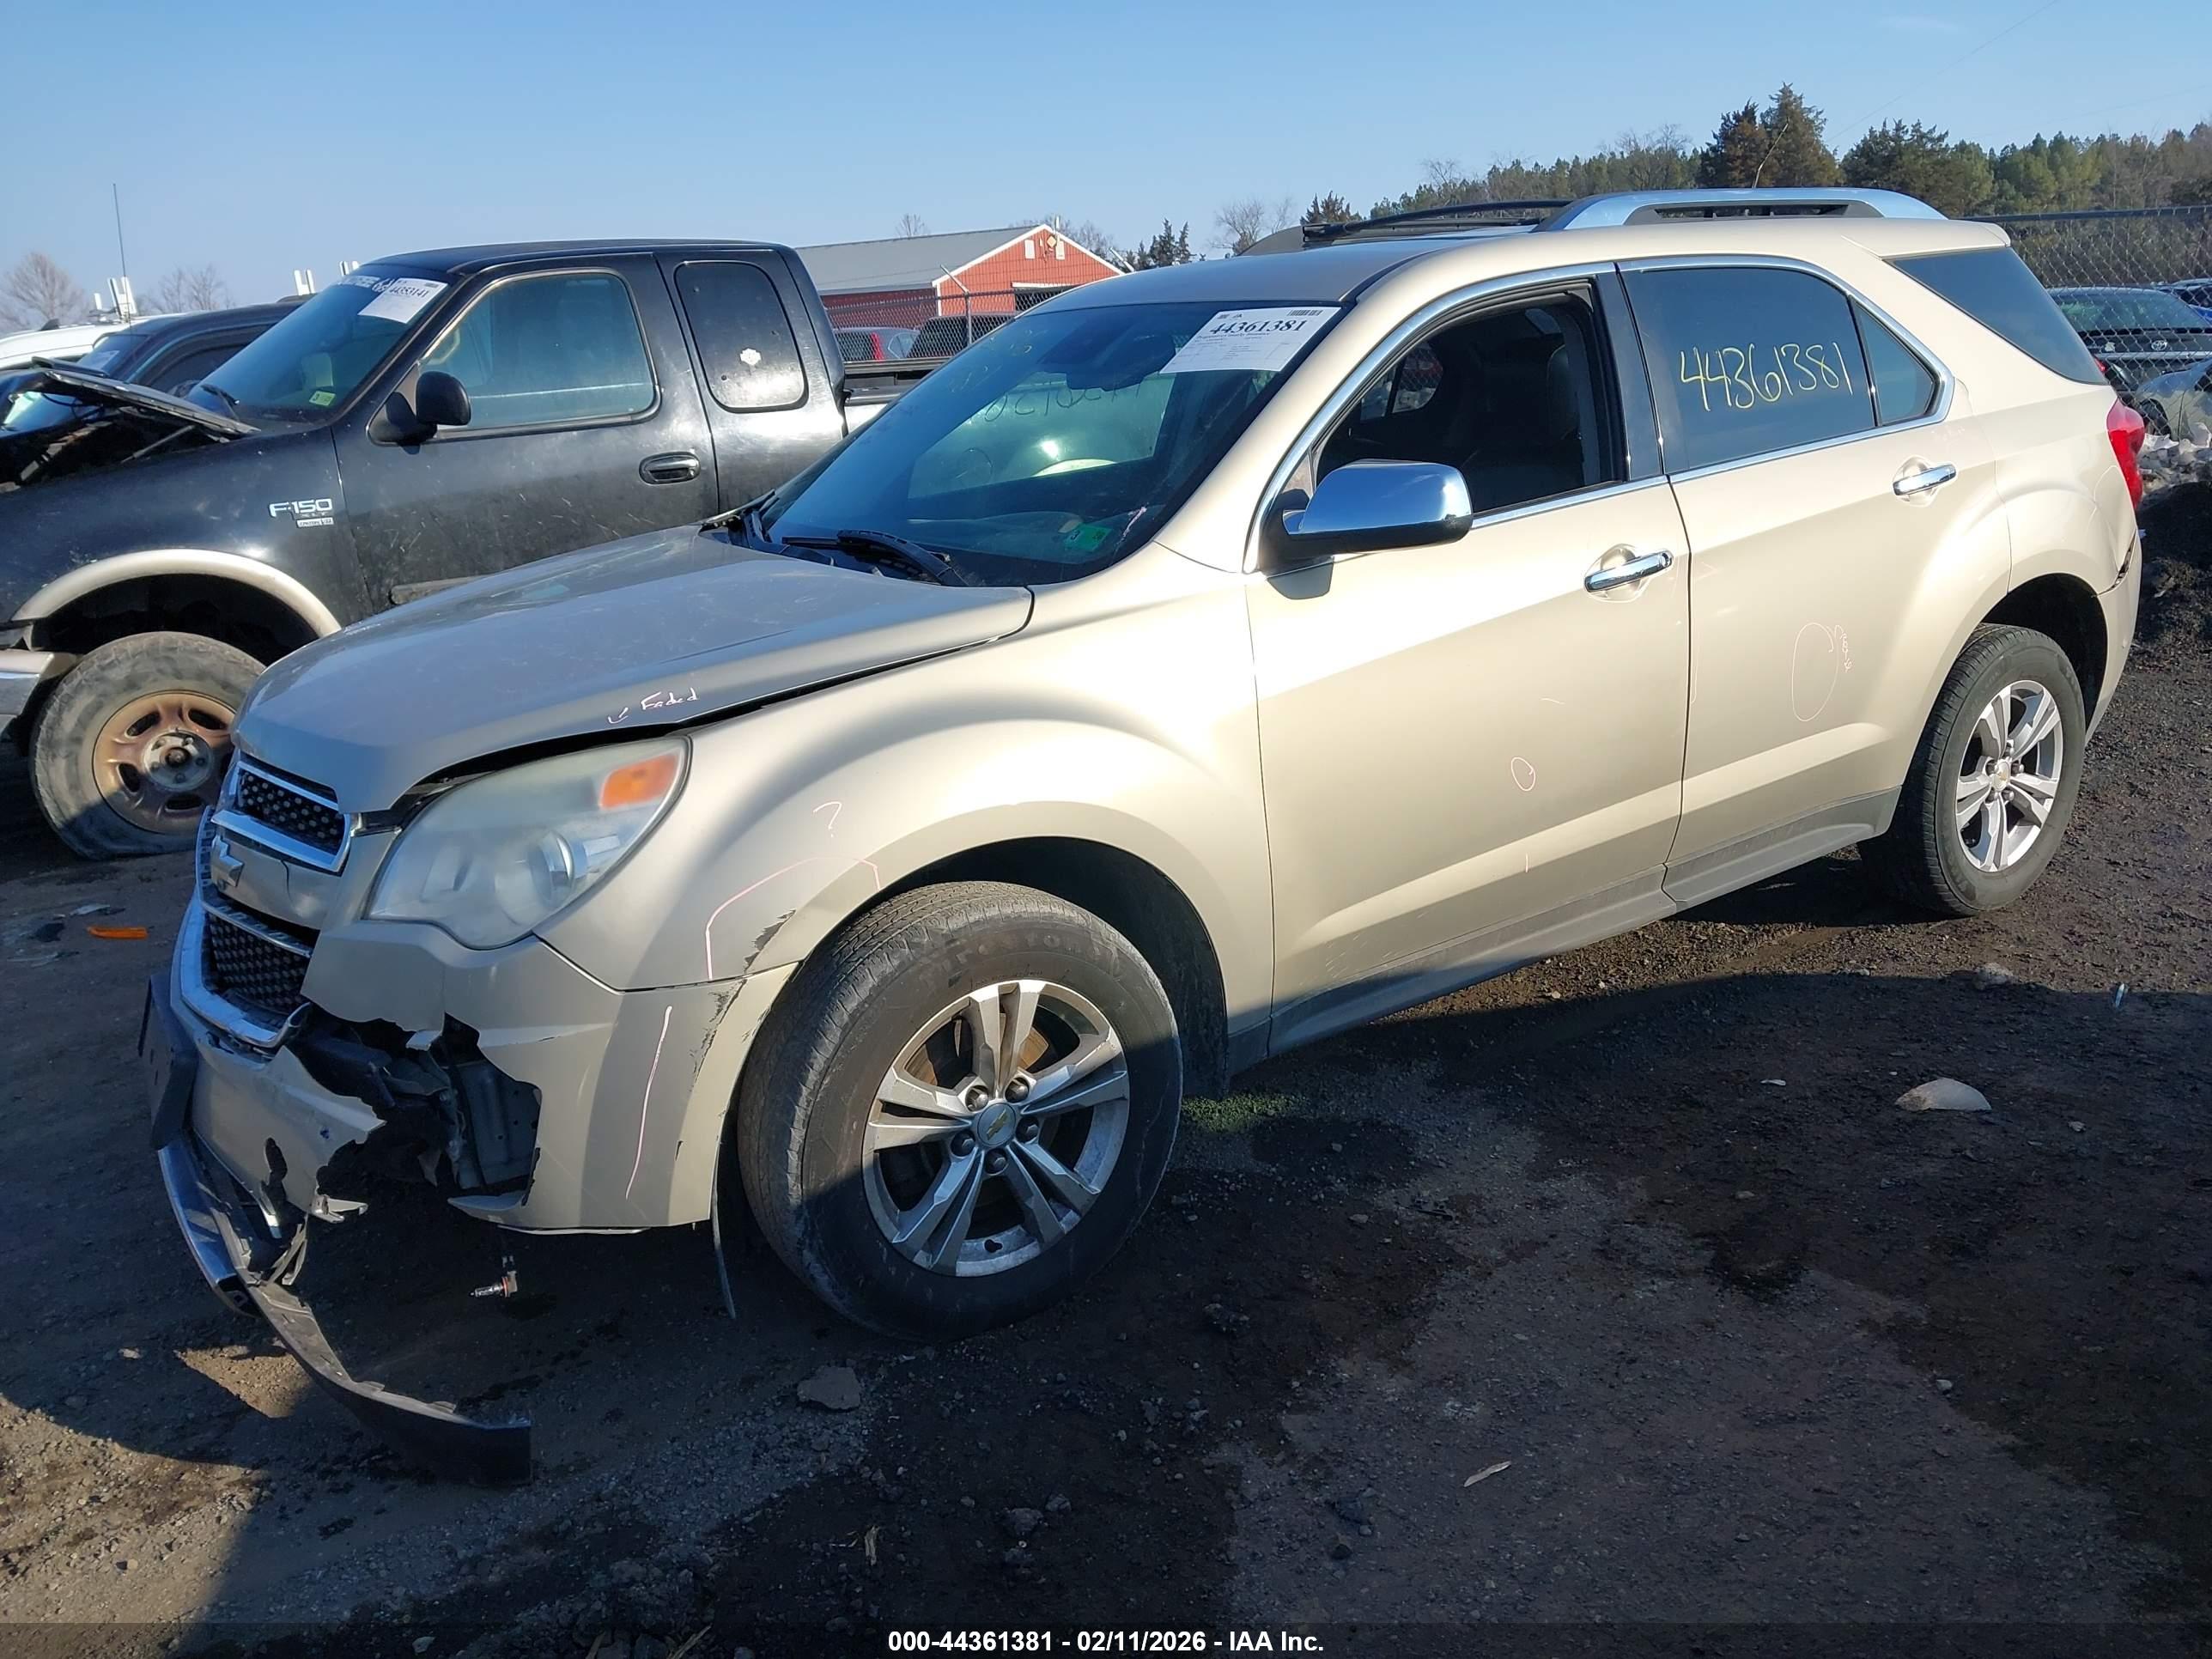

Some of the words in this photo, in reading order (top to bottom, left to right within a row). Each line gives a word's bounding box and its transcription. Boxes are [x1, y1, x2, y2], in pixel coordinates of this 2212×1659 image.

[1209, 319, 1309, 335] 44361381
[1680, 342, 1853, 411] 44361381
[641, 687, 698, 711] Faded
